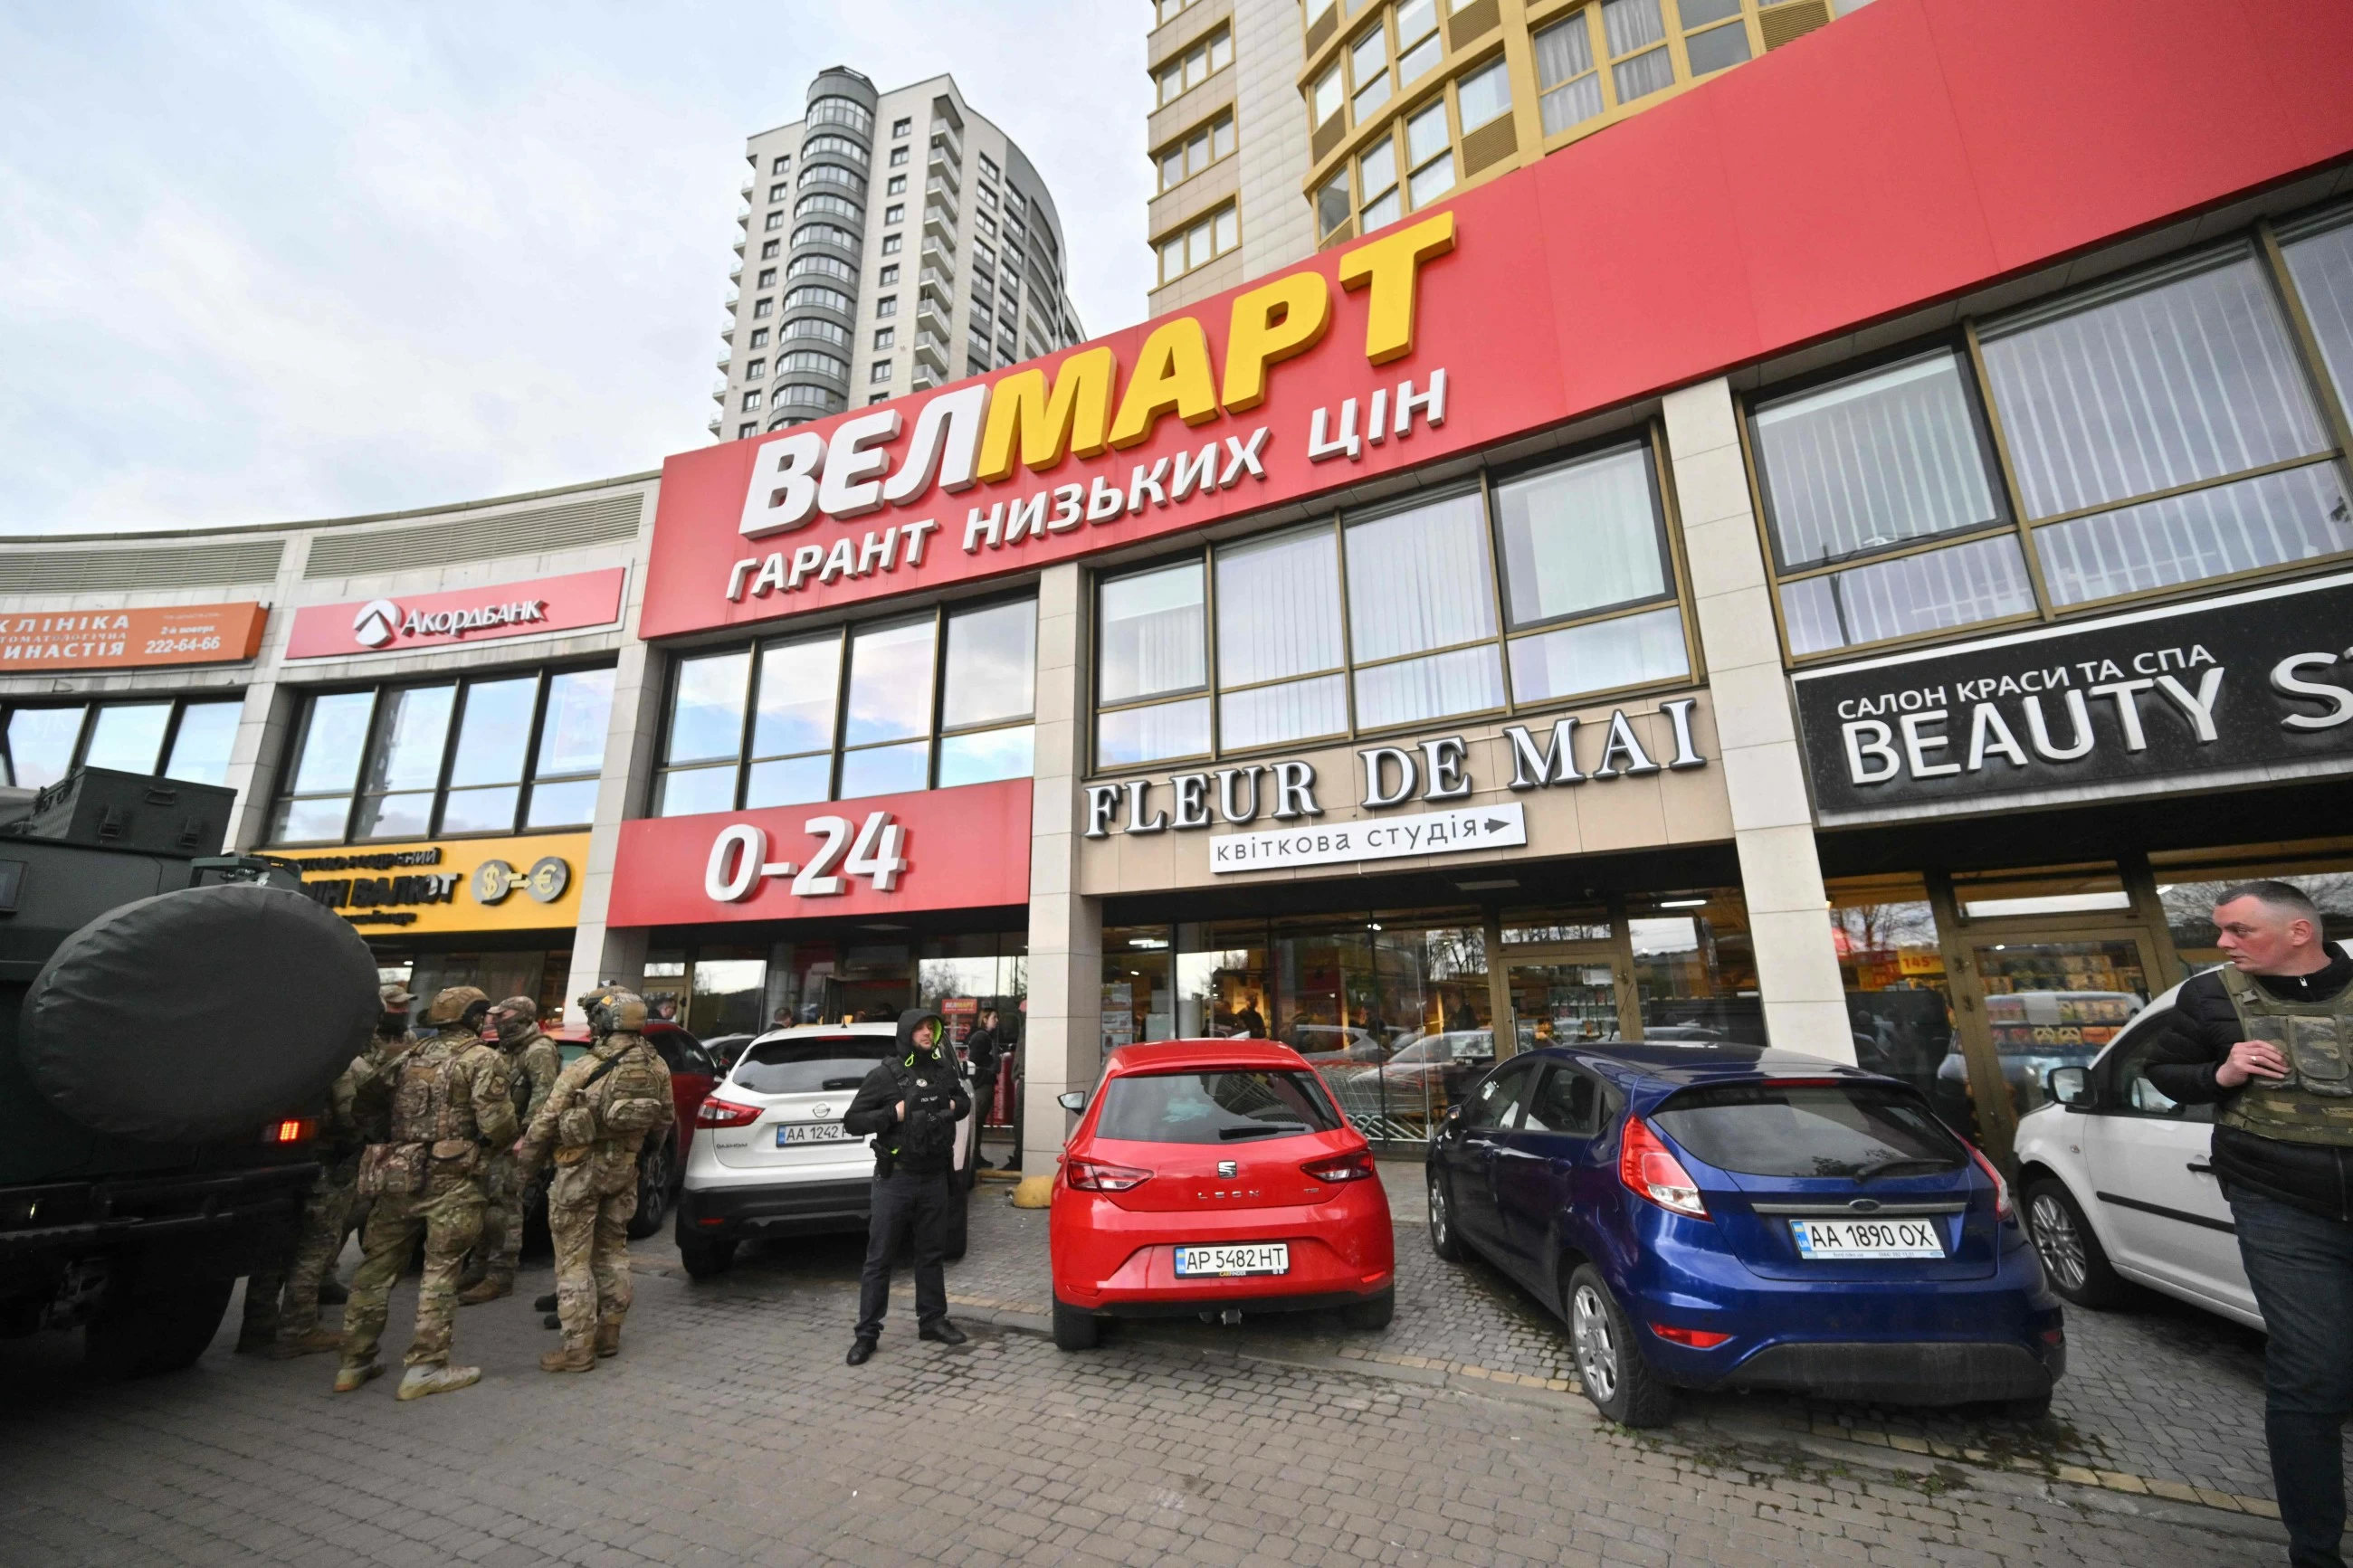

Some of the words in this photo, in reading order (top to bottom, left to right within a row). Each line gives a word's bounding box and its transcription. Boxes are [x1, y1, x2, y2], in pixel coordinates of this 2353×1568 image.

[738, 210, 1456, 539] ВЕЛМАРТ
[725, 518, 938, 603] ГАРАНТ
[962, 426, 1269, 555] НИЗЬКИХ
[1308, 367, 1448, 462] ЦІН
[145, 636, 221, 654] 222-64-66
[1837, 685, 1947, 720] САЛОН
[1957, 665, 2071, 702] КРАСИ
[2076, 658, 2120, 683] ТА
[2133, 643, 2216, 678] СПА
[1841, 666, 2226, 786] BEAUTY
[2270, 646, 2353, 733] S
[1084, 758, 1324, 839] FLEUR
[1358, 735, 1474, 811] DE
[1503, 697, 1708, 791] MAI
[704, 811, 908, 903] 0-24
[1216, 832, 1351, 863] квіткова
[1367, 813, 1480, 851] студія
[786, 1127, 805, 1142] AA
[810, 1126, 839, 1140] 1242
[1186, 1251, 1211, 1269] AP
[1215, 1250, 1256, 1269] 5482
[1260, 1248, 1284, 1267] HT
[1811, 1225, 1843, 1248] AA
[1846, 1224, 1896, 1248] 1890
[1899, 1224, 1934, 1247] OX
